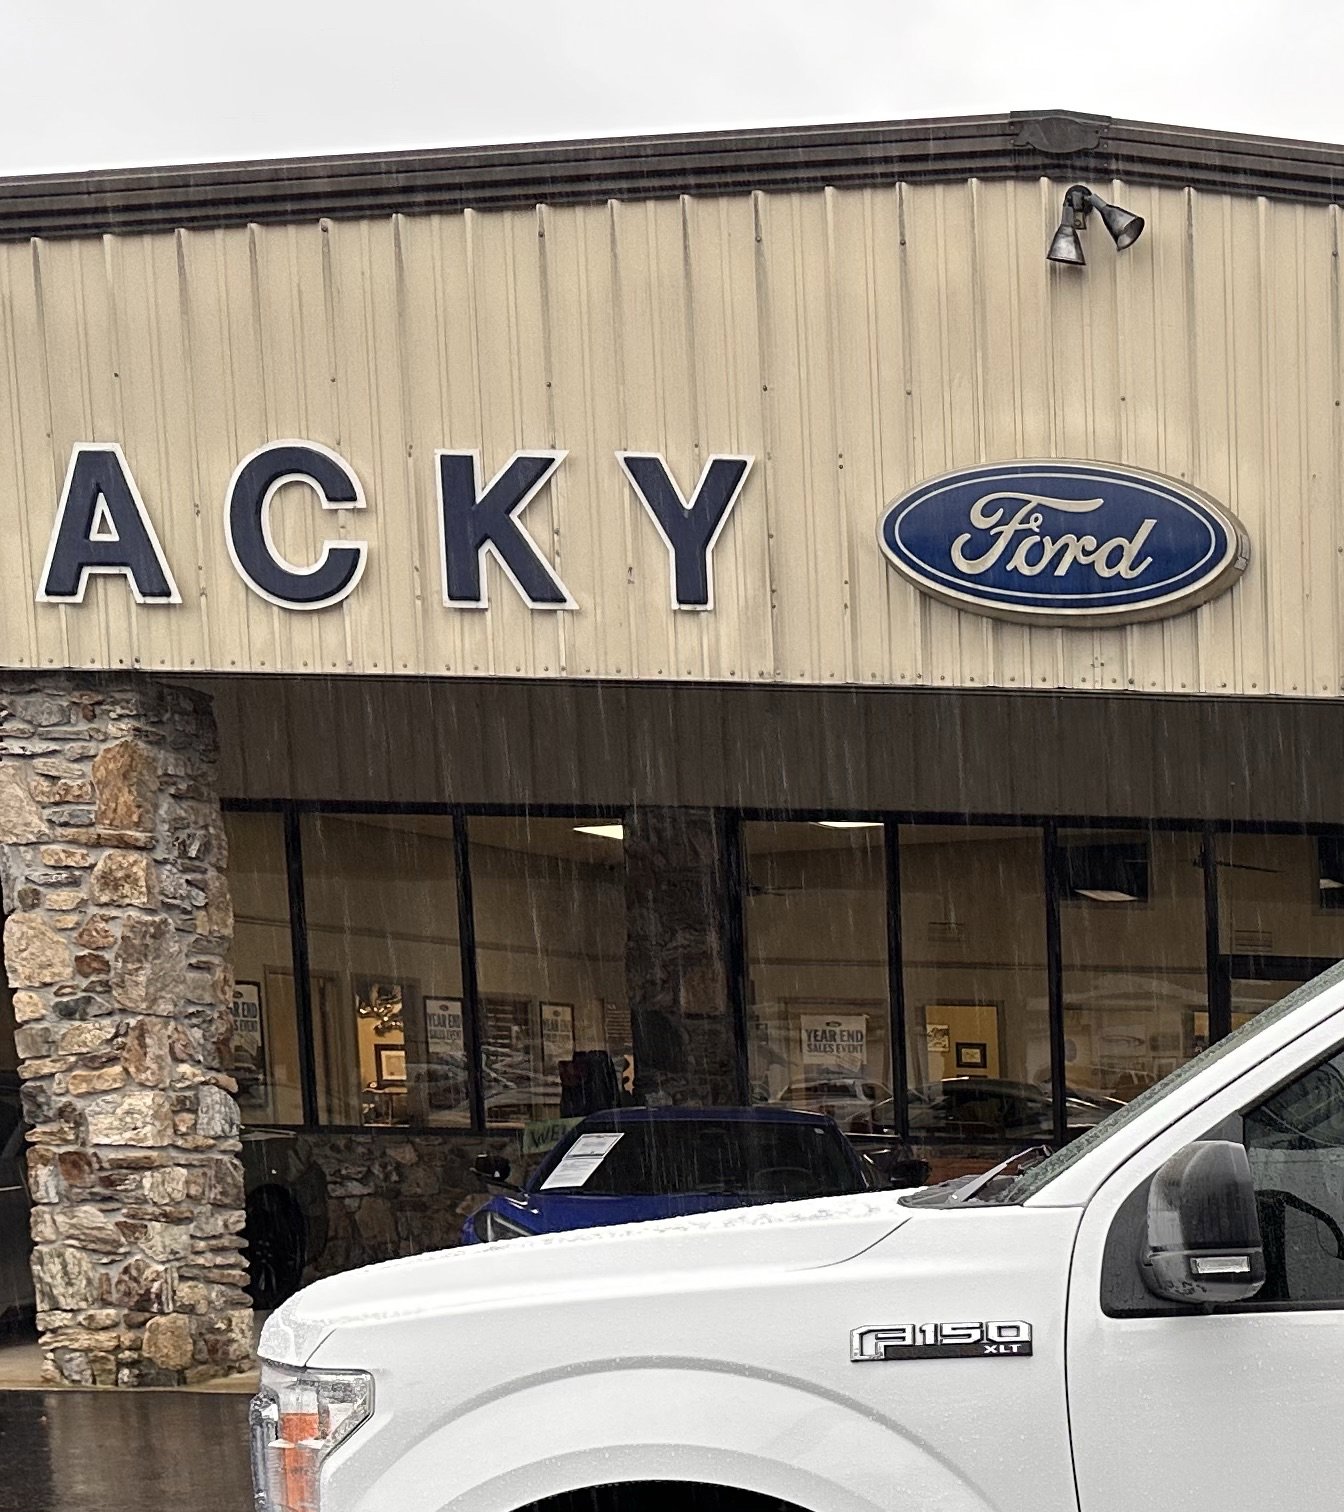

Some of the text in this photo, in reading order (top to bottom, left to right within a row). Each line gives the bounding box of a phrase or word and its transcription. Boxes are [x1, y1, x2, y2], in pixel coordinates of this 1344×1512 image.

[35, 438, 757, 612] ACKY
[951, 492, 1157, 579] Ford
[806, 1029, 864, 1043] YEAR END
[807, 1044, 863, 1054] SALES EVENT
[850, 1320, 1032, 1361] F150
[983, 1344, 1021, 1355] XLT
